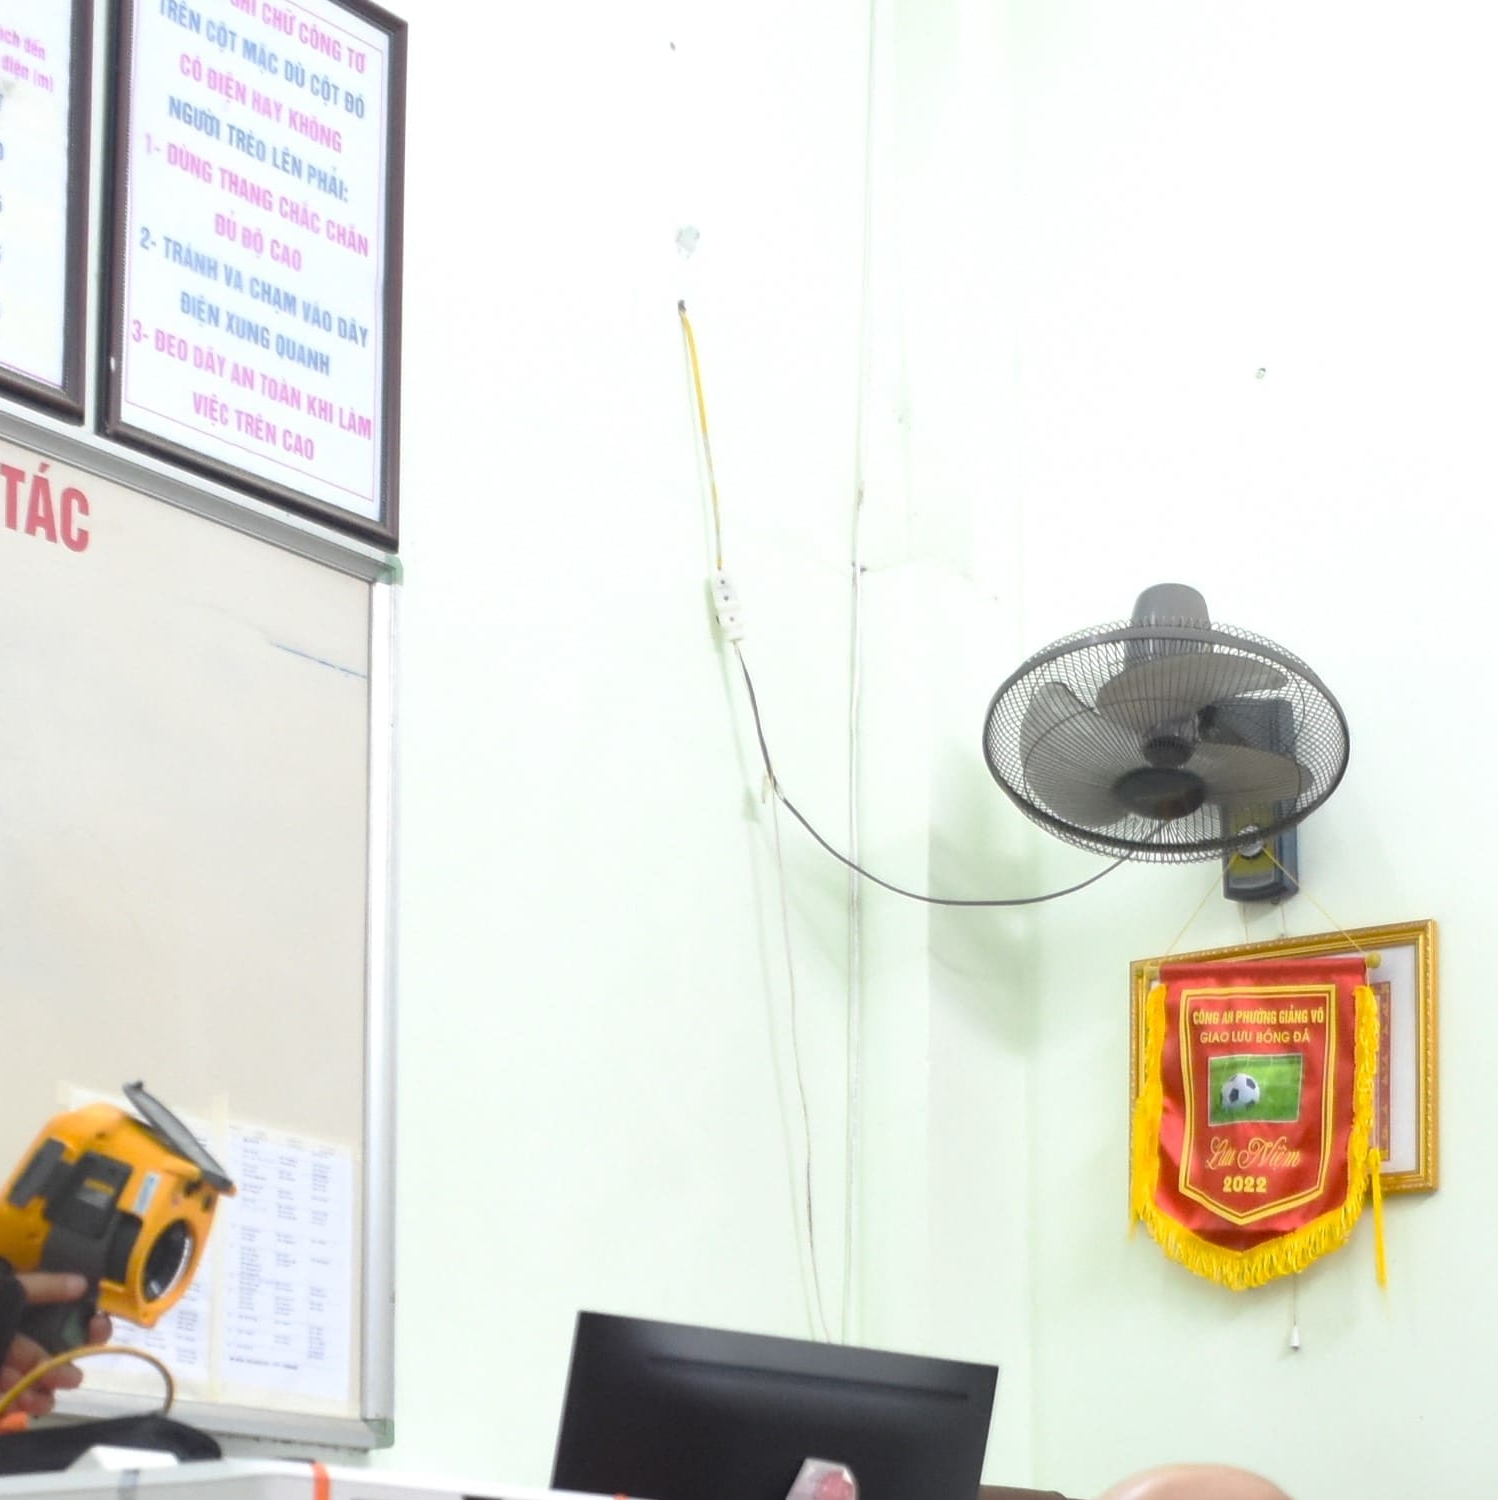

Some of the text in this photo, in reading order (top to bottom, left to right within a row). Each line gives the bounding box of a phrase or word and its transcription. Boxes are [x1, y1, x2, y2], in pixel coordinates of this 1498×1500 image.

[159, 0, 201, 35] TRÊN
[206, 19, 237, 53] CỘT
[310, 74, 341, 107] CỘT
[298, 21, 342, 63] CÔNG
[168, 95, 221, 141] NGƯỜI
[272, 146, 303, 180] LÊN
[179, 53, 342, 153] CÓ ĐIỆN HAY KHÔNG
[218, 166, 273, 212] THANG
[214, 209, 237, 242] ĐỦ
[269, 238, 302, 272] CAO
[163, 236, 218, 281] TRÁNH
[223, 263, 244, 293] VA
[249, 276, 297, 315] CHẠM
[302, 300, 333, 333] VÀO
[337, 317, 369, 348] DÂY
[180, 291, 331, 377] ĐIỆN XUNG QUANH
[154, 328, 189, 363] ĐEO
[193, 345, 226, 378] DÂY
[230, 362, 255, 391] AN
[259, 372, 302, 412] TOÀN
[307, 393, 334, 424] KHI
[338, 407, 372, 441] LÀM
[192, 391, 315, 461] VIỆC TRÊN CAO
[0, 459, 91, 553] TÁC
[1192, 1008, 1220, 1025] CÔNG
[1221, 1009, 1234, 1025] AN
[1199, 1027, 1311, 1043] GIAO LƯU BÓNG ĐÁ
[1222, 1175, 1267, 1193] 2022
